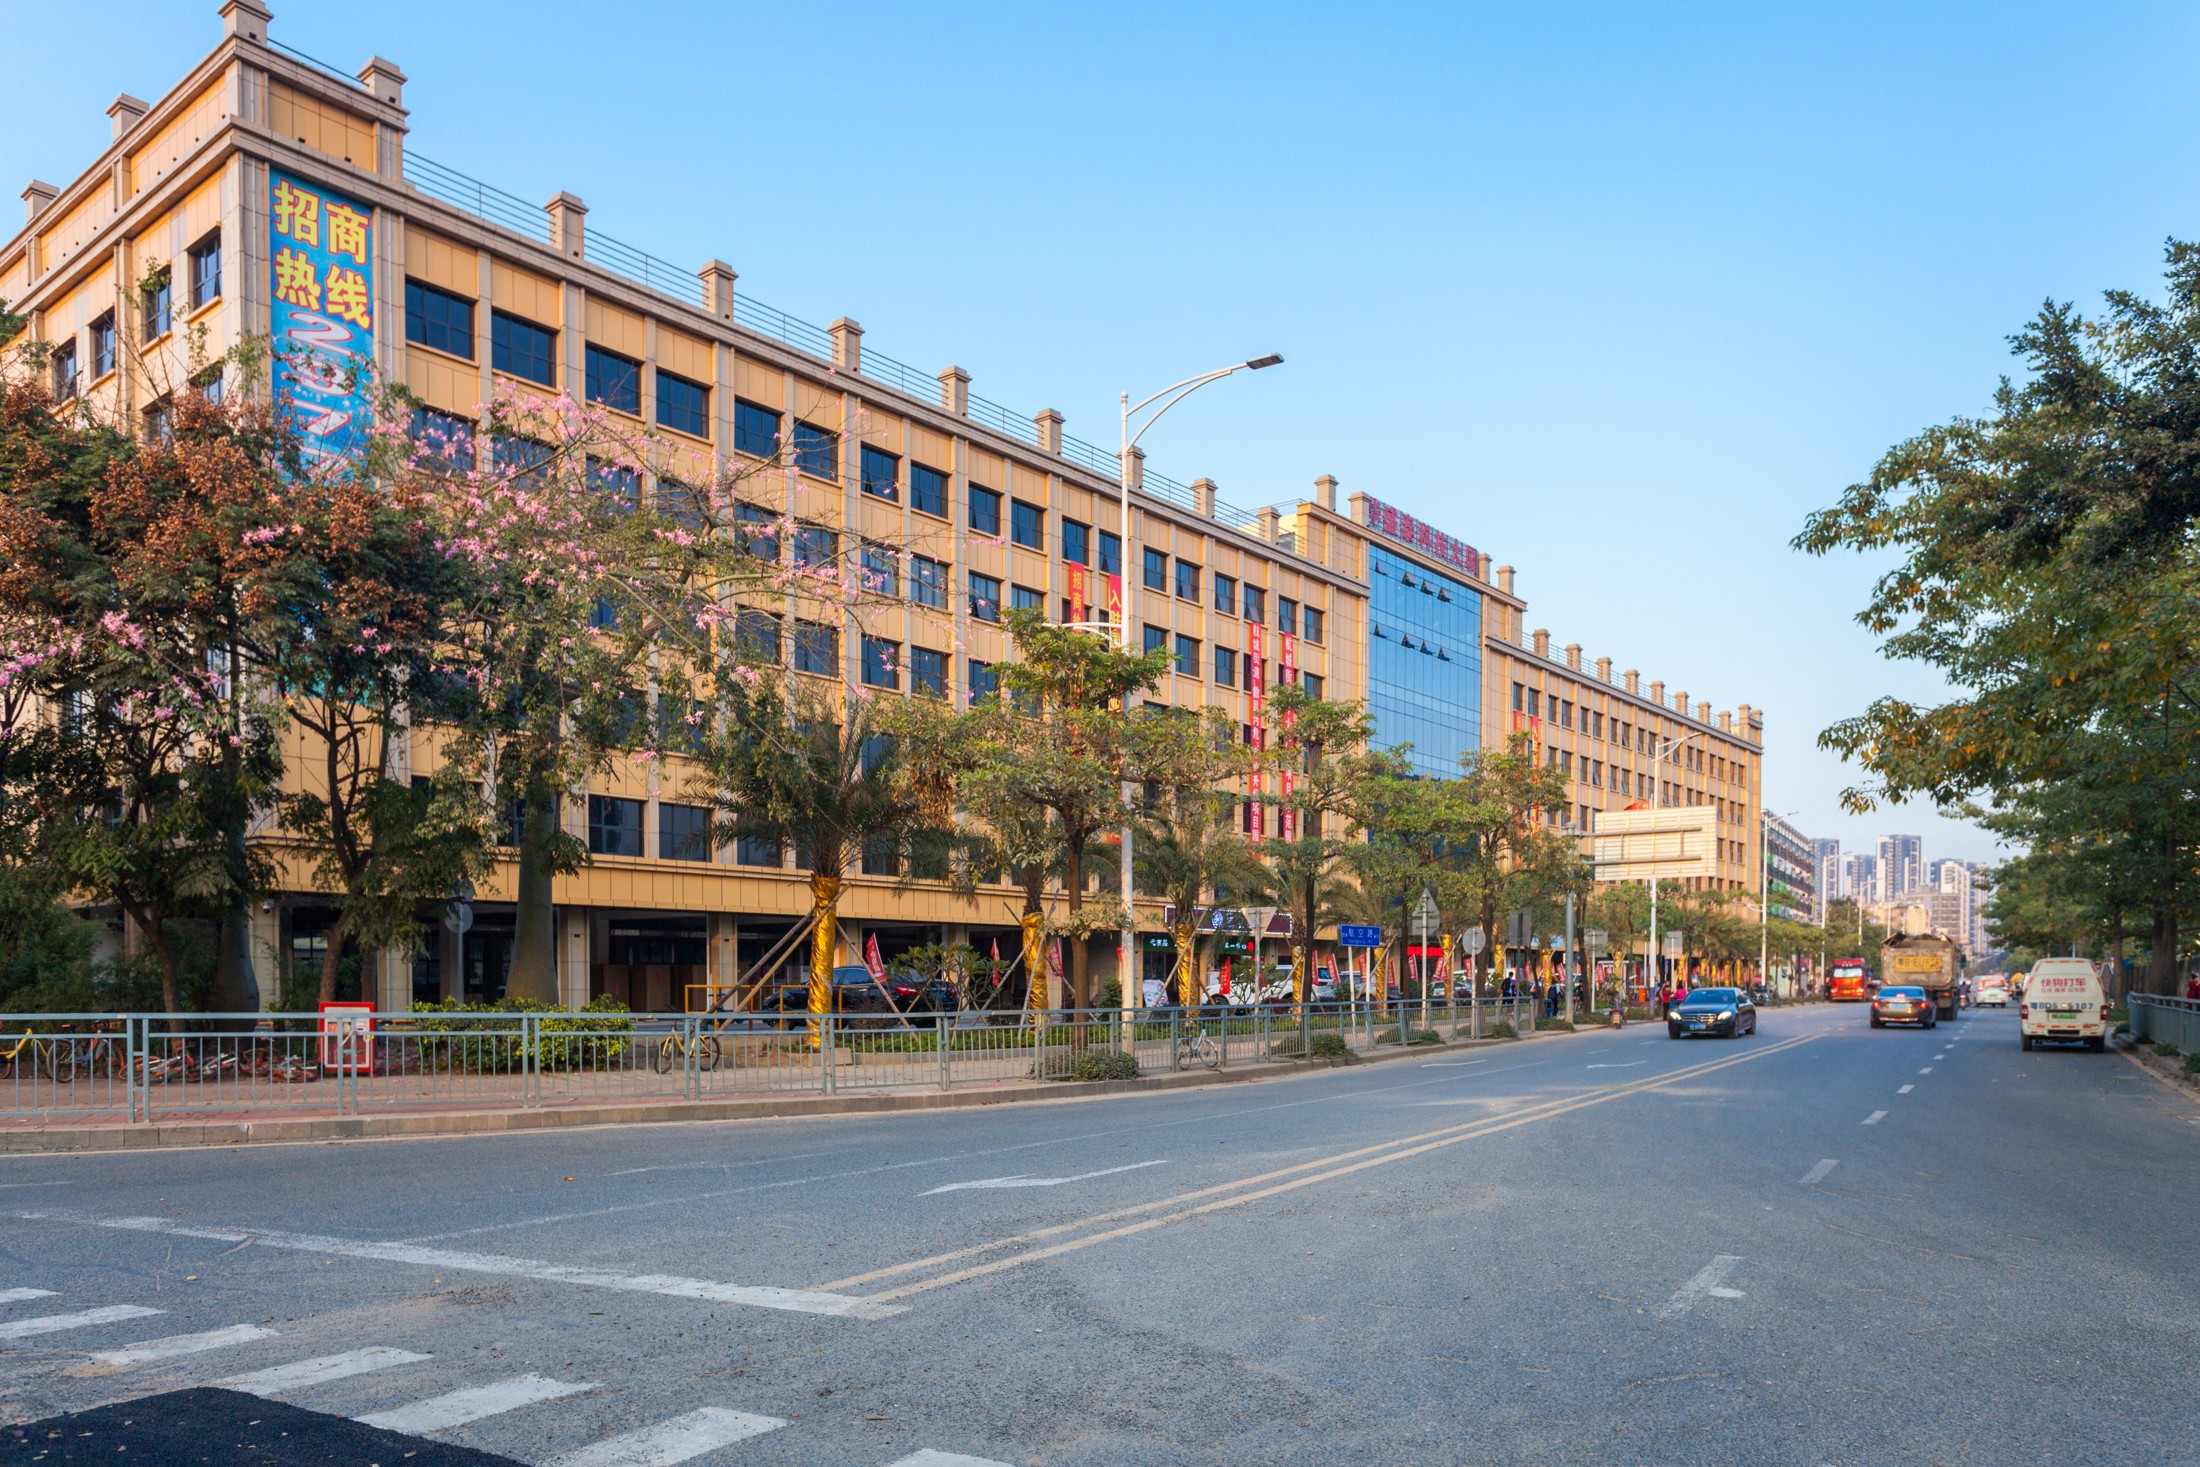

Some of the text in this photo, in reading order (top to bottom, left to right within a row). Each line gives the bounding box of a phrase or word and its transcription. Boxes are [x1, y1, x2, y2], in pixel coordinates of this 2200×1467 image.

[272, 177, 370, 265] 招商
[272, 244, 372, 330] 热线
[1348, 928, 1374, 938] 航空路
[2041, 978, 2086, 988] 快狗打车
